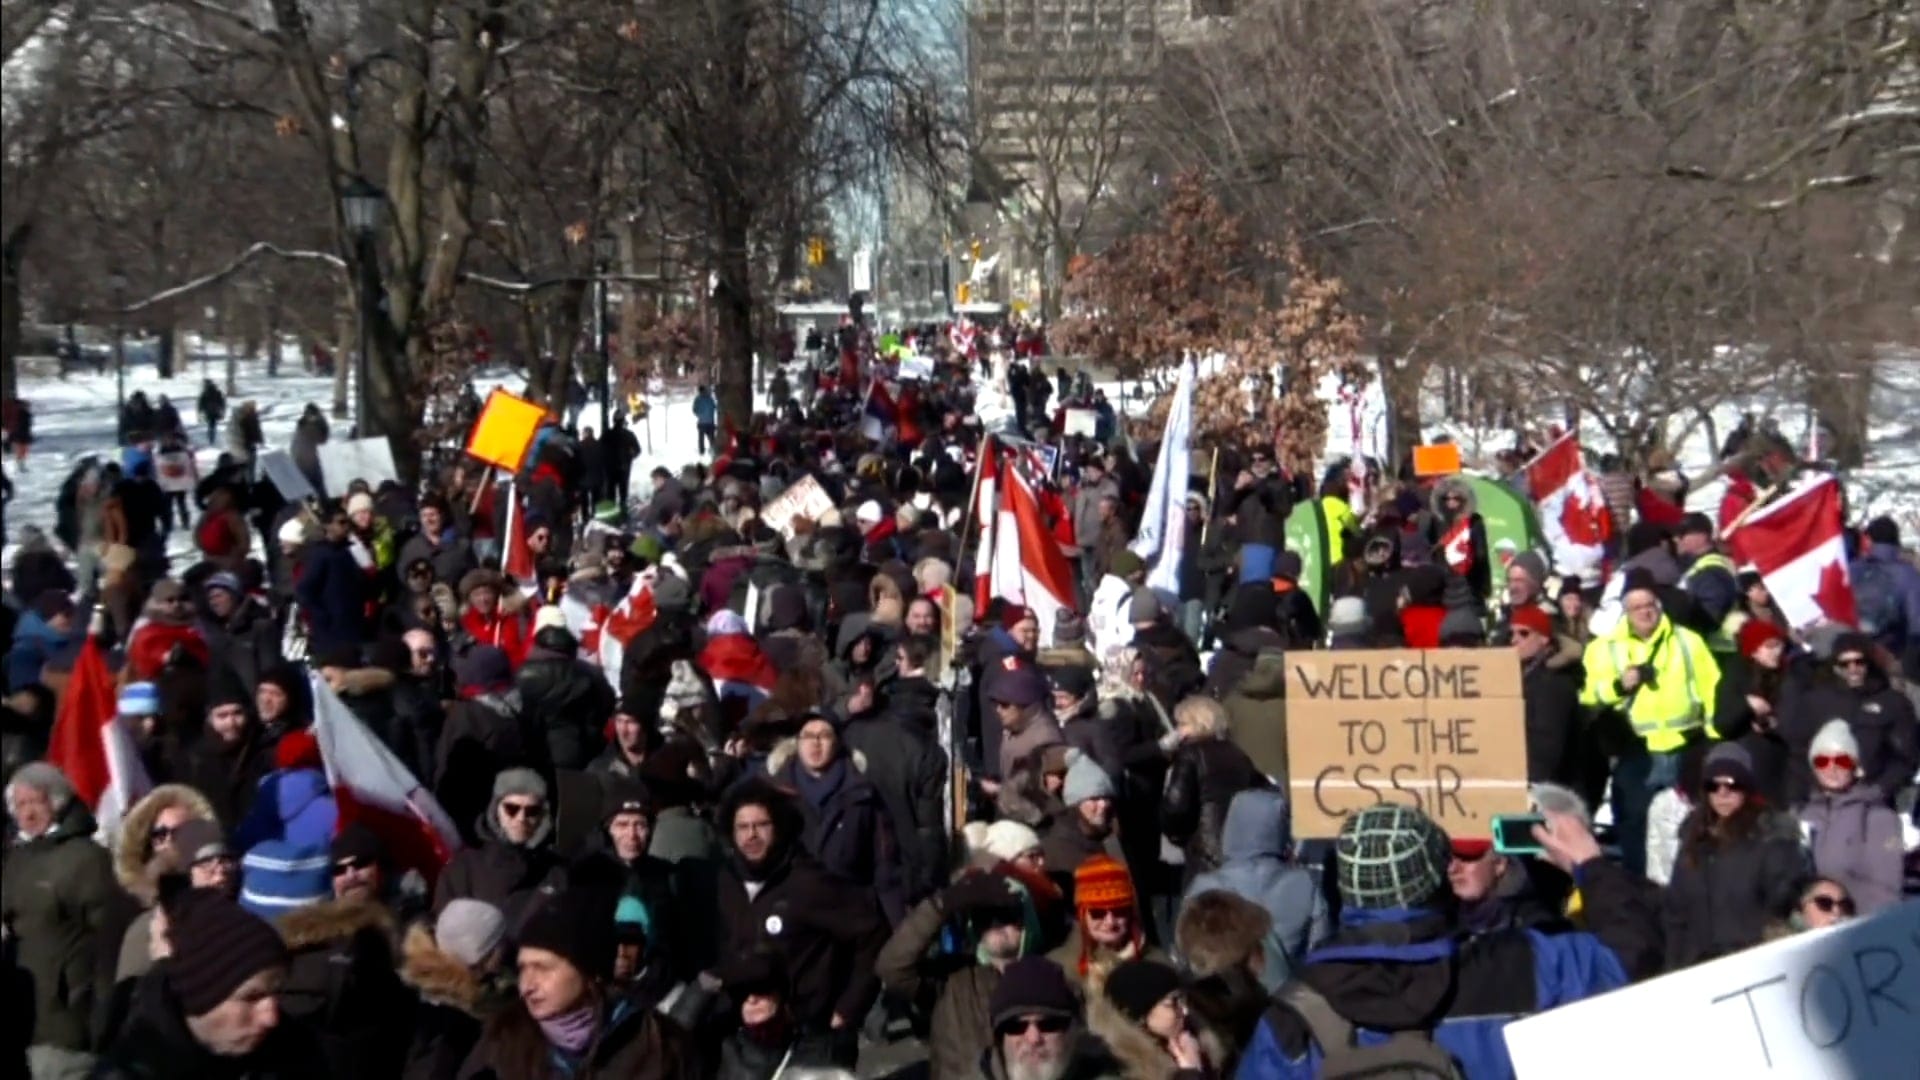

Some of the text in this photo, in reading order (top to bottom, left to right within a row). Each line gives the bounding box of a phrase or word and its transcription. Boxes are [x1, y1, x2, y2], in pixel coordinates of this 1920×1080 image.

[1295, 663, 1481, 699] WELCOME
[1339, 718, 1479, 755] TO THE
[1711, 930, 1920, 1069] TOR
